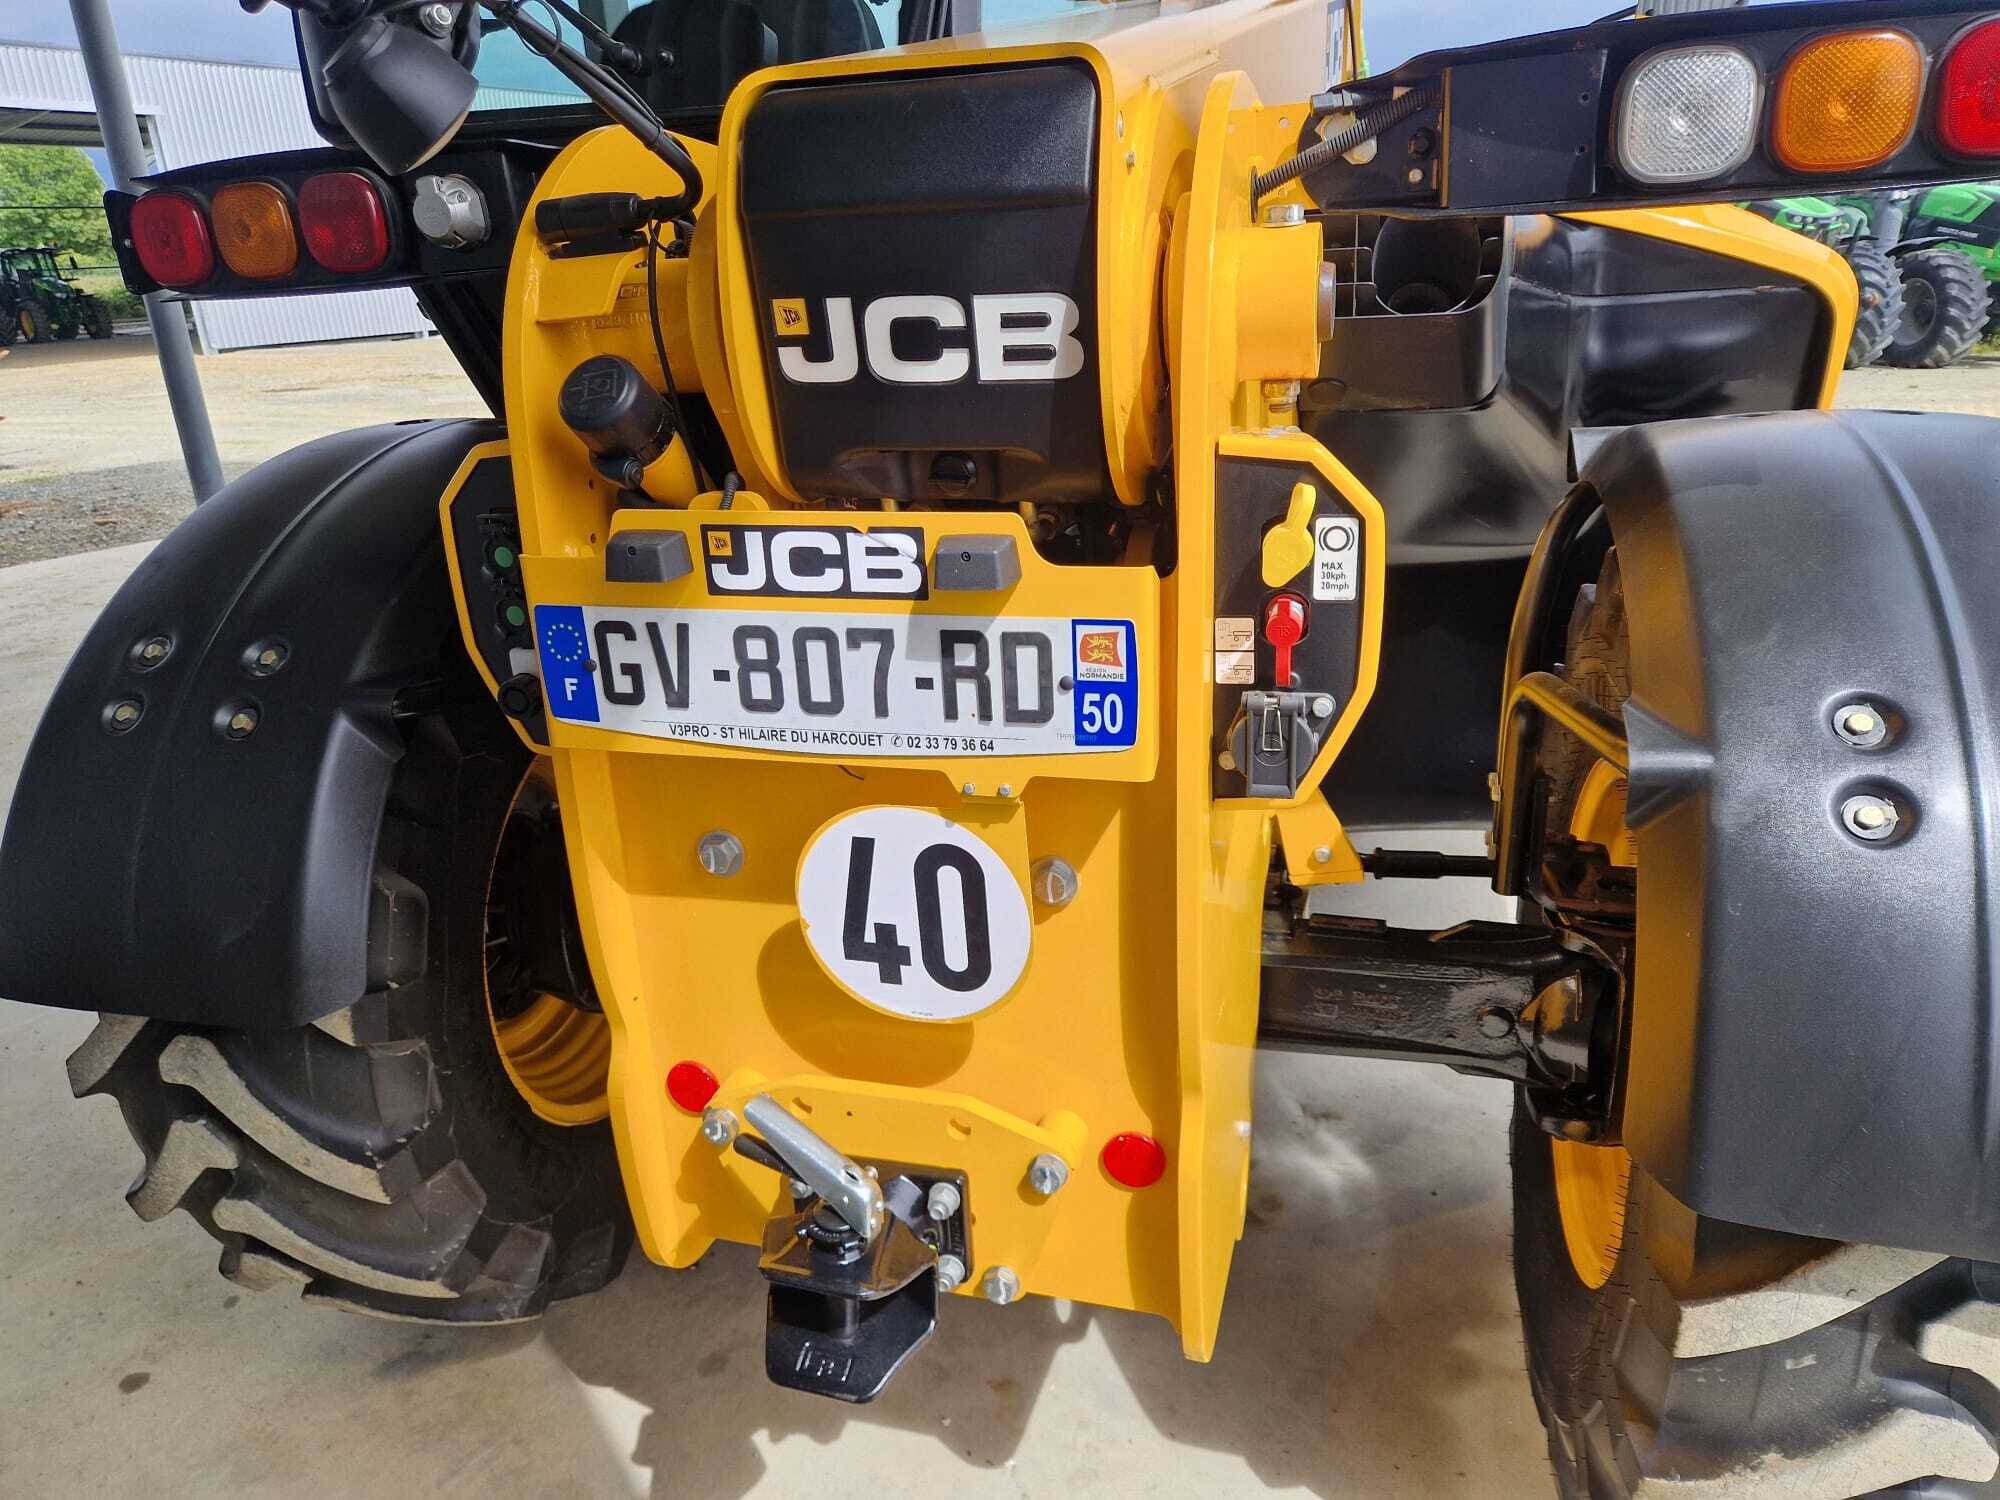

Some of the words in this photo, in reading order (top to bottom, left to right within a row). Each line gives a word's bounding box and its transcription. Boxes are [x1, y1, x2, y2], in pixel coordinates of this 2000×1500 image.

[777, 292, 1085, 383] JCB
[711, 531, 922, 593] JCB
[1321, 562, 1343, 570] MAX
[1321, 571, 1346, 581] 30kph
[1321, 581, 1350, 592] 20mph
[594, 620, 1055, 724] GV-807-RD
[1079, 672, 1125, 680] NORMANDIE
[564, 677, 579, 701] F
[1082, 692, 1124, 734] 50
[669, 724, 710, 738] V3PRO
[720, 726, 735, 740] ST
[739, 728, 788, 742] HILAIRE
[791, 730, 808, 743] DU
[812, 731, 883, 747] HARCOUET
[907, 736, 921, 749] 02
[925, 737, 940, 750] 33
[943, 737, 958, 751] 79
[961, 738, 976, 751] 36
[979, 739, 994, 752] 64
[843, 836, 992, 992] 40
